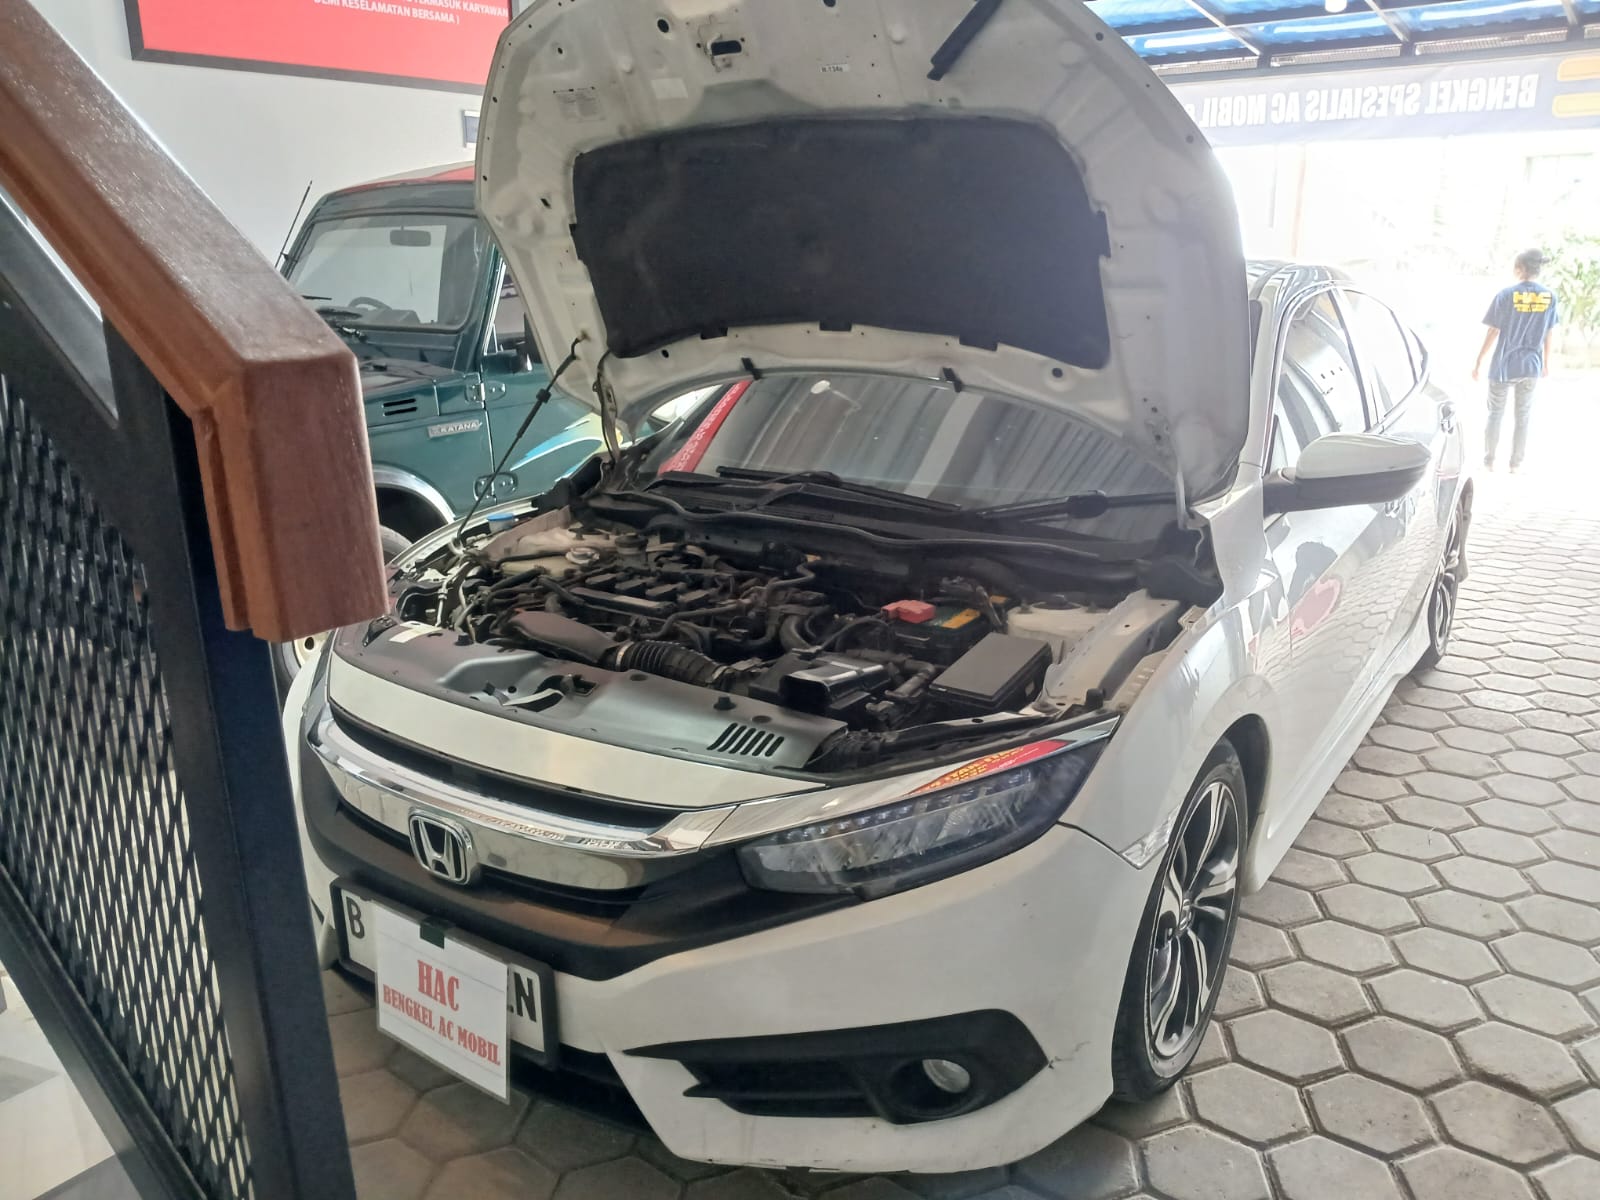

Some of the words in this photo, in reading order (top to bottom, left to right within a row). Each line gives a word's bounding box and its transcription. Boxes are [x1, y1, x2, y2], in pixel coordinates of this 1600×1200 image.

[342, 0, 411, 17] KESELAMATAN
[412, 8, 455, 24] BERSAMA
[462, 3, 508, 17] KARYAWAN
[346, 897, 365, 939] B
[507, 967, 537, 1023] N
[417, 959, 460, 1012] HAC
[382, 984, 435, 1031] BENGKEL
[438, 1016, 454, 1040] AC
[457, 1026, 501, 1066] MOBIL
